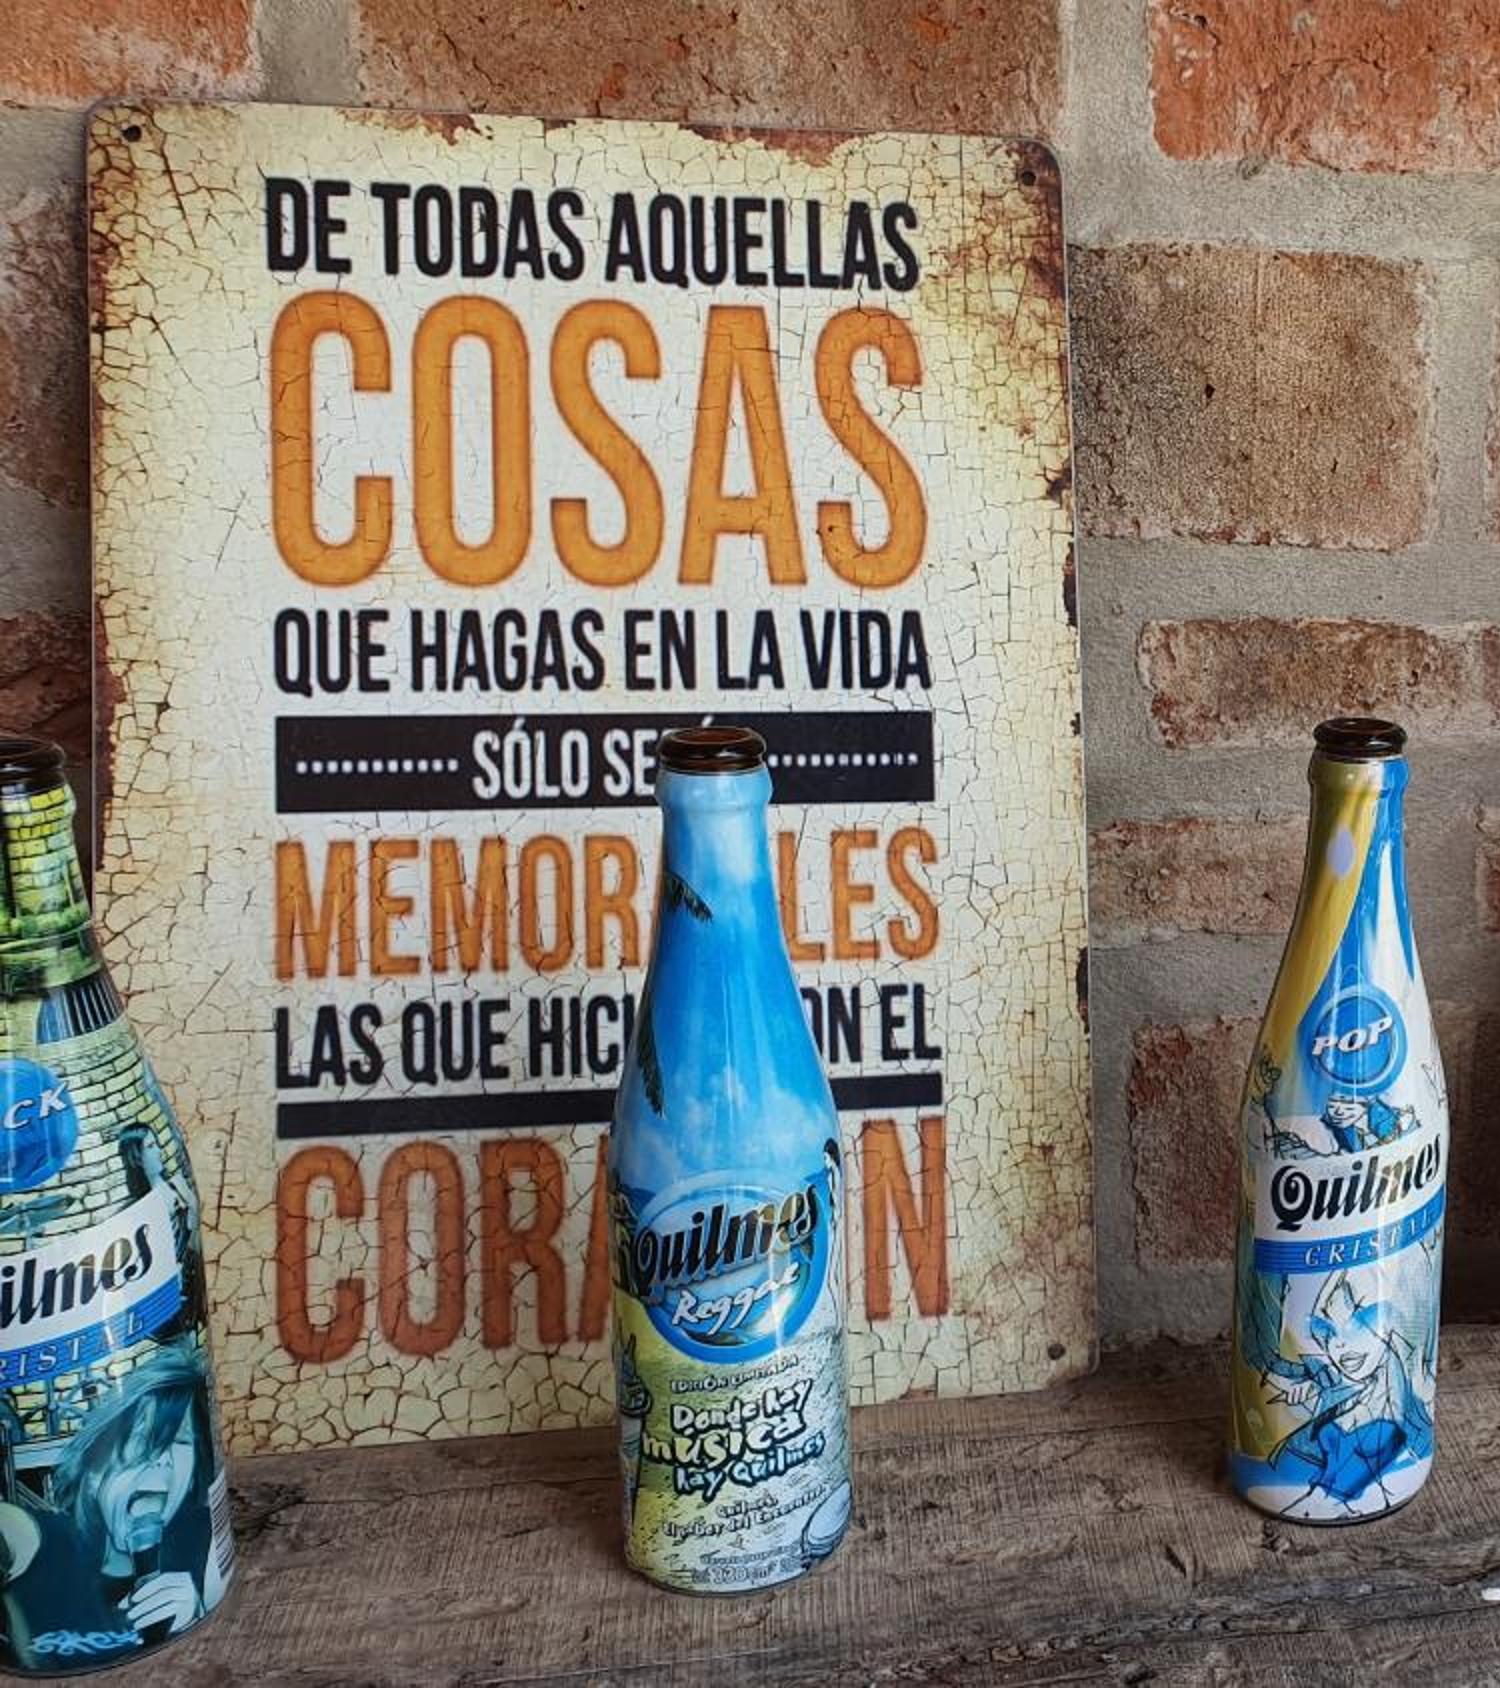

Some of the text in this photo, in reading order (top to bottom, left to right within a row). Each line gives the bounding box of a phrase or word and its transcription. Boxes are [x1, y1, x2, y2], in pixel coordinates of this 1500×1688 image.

[264, 176, 918, 292] DE TODAS AQUELLAS
[269, 289, 928, 588] COSAS
[273, 607, 933, 698] QUE HAGAS EN LA VIDA
[472, 716, 590, 799] SÓLO
[275, 827, 941, 980] MEMORLES
[275, 1003, 384, 1089] LAS
[401, 998, 508, 1087] QUE
[880, 983, 942, 1060] EL
[1312, 1016, 1394, 1056] POP
[4, 1082, 68, 1130] CK
[1271, 1133, 1441, 1232] Quilmes
[0, 1223, 153, 1329] ilmes
[275, 1116, 951, 1365] CORN
[635, 1184, 819, 1298] Quilmes
